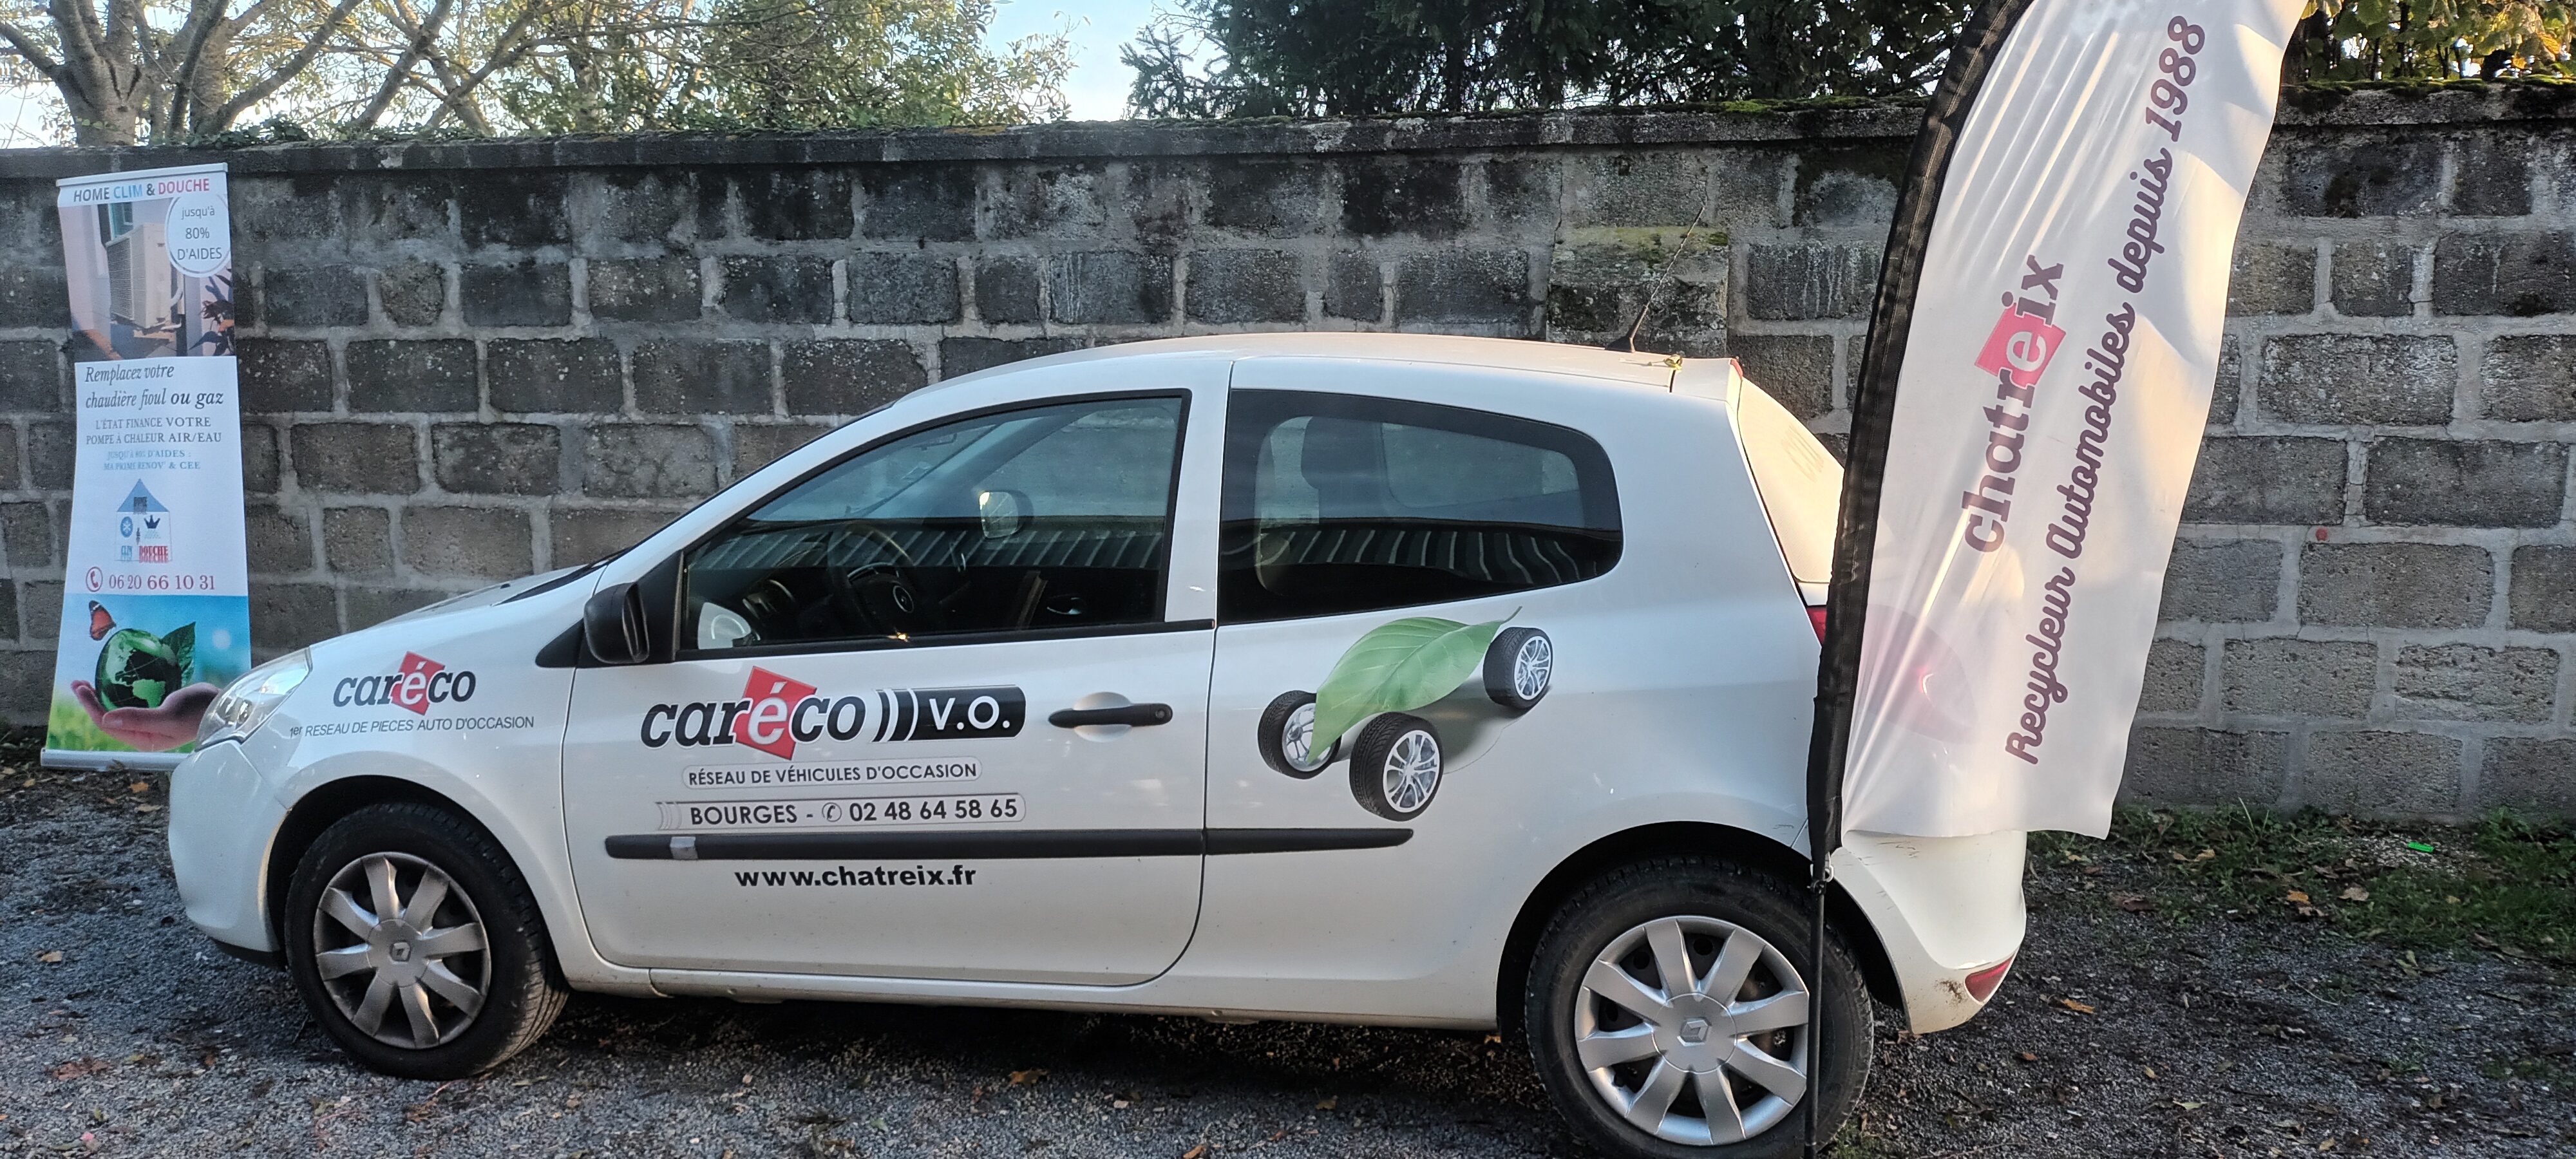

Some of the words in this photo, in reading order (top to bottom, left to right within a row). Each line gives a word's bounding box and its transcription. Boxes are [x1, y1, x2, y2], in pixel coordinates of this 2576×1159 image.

[73, 187, 109, 202] HOME
[113, 184, 142, 199] CLIM
[146, 183, 155, 196] &
[158, 178, 209, 194] DOUCHE
[181, 205, 215, 220] jusqu'à
[185, 227, 210, 239] 80%
[177, 247, 222, 260] D'AIDES
[84, 364, 141, 385] Remplacez
[144, 365, 175, 378] votre
[86, 390, 137, 408] chaudière
[138, 388, 166, 410] fioul
[171, 393, 191, 405] ou
[194, 392, 223, 409] gaz
[2005, 566, 2076, 764] Recycleur
[2108, 147, 2173, 294] depuis
[2145, 15, 2205, 142] 1988
[1962, 254, 2063, 552] chatreix
[126, 418, 162, 428] FINANCE
[166, 417, 211, 427] VOTRE
[86, 435, 114, 444] POMPE
[124, 433, 164, 443] CHALEUR
[169, 432, 222, 442] AIR/EAU
[180, 461, 200, 469] CEE
[109, 574, 124, 589] 06
[128, 574, 142, 589] 20
[147, 575, 169, 590] 66
[175, 574, 193, 590] 10
[200, 575, 214, 590] 31
[333, 661, 477, 707] caréco
[641, 681, 867, 748] caréco
[929, 697, 1010, 731] V.O.
[305, 723, 350, 737] RESEAU
[352, 721, 368, 733] DE
[371, 720, 413, 732] PIECES
[418, 718, 452, 730] AUTO
[455, 716, 535, 730] D'OCCASION
[689, 768, 745, 786] RÉSEAU
[752, 770, 770, 783] DE
[776, 765, 860, 783] VÉHICULES
[866, 764, 976, 780] D'OCCASION
[690, 805, 797, 825] BOURGES
[849, 802, 876, 822] 02
[884, 802, 911, 820] 48
[920, 800, 947, 819] 64
[954, 800, 981, 818] 58
[990, 798, 1017, 818] 65
[735, 865, 976, 888] www.chatreix.fr
